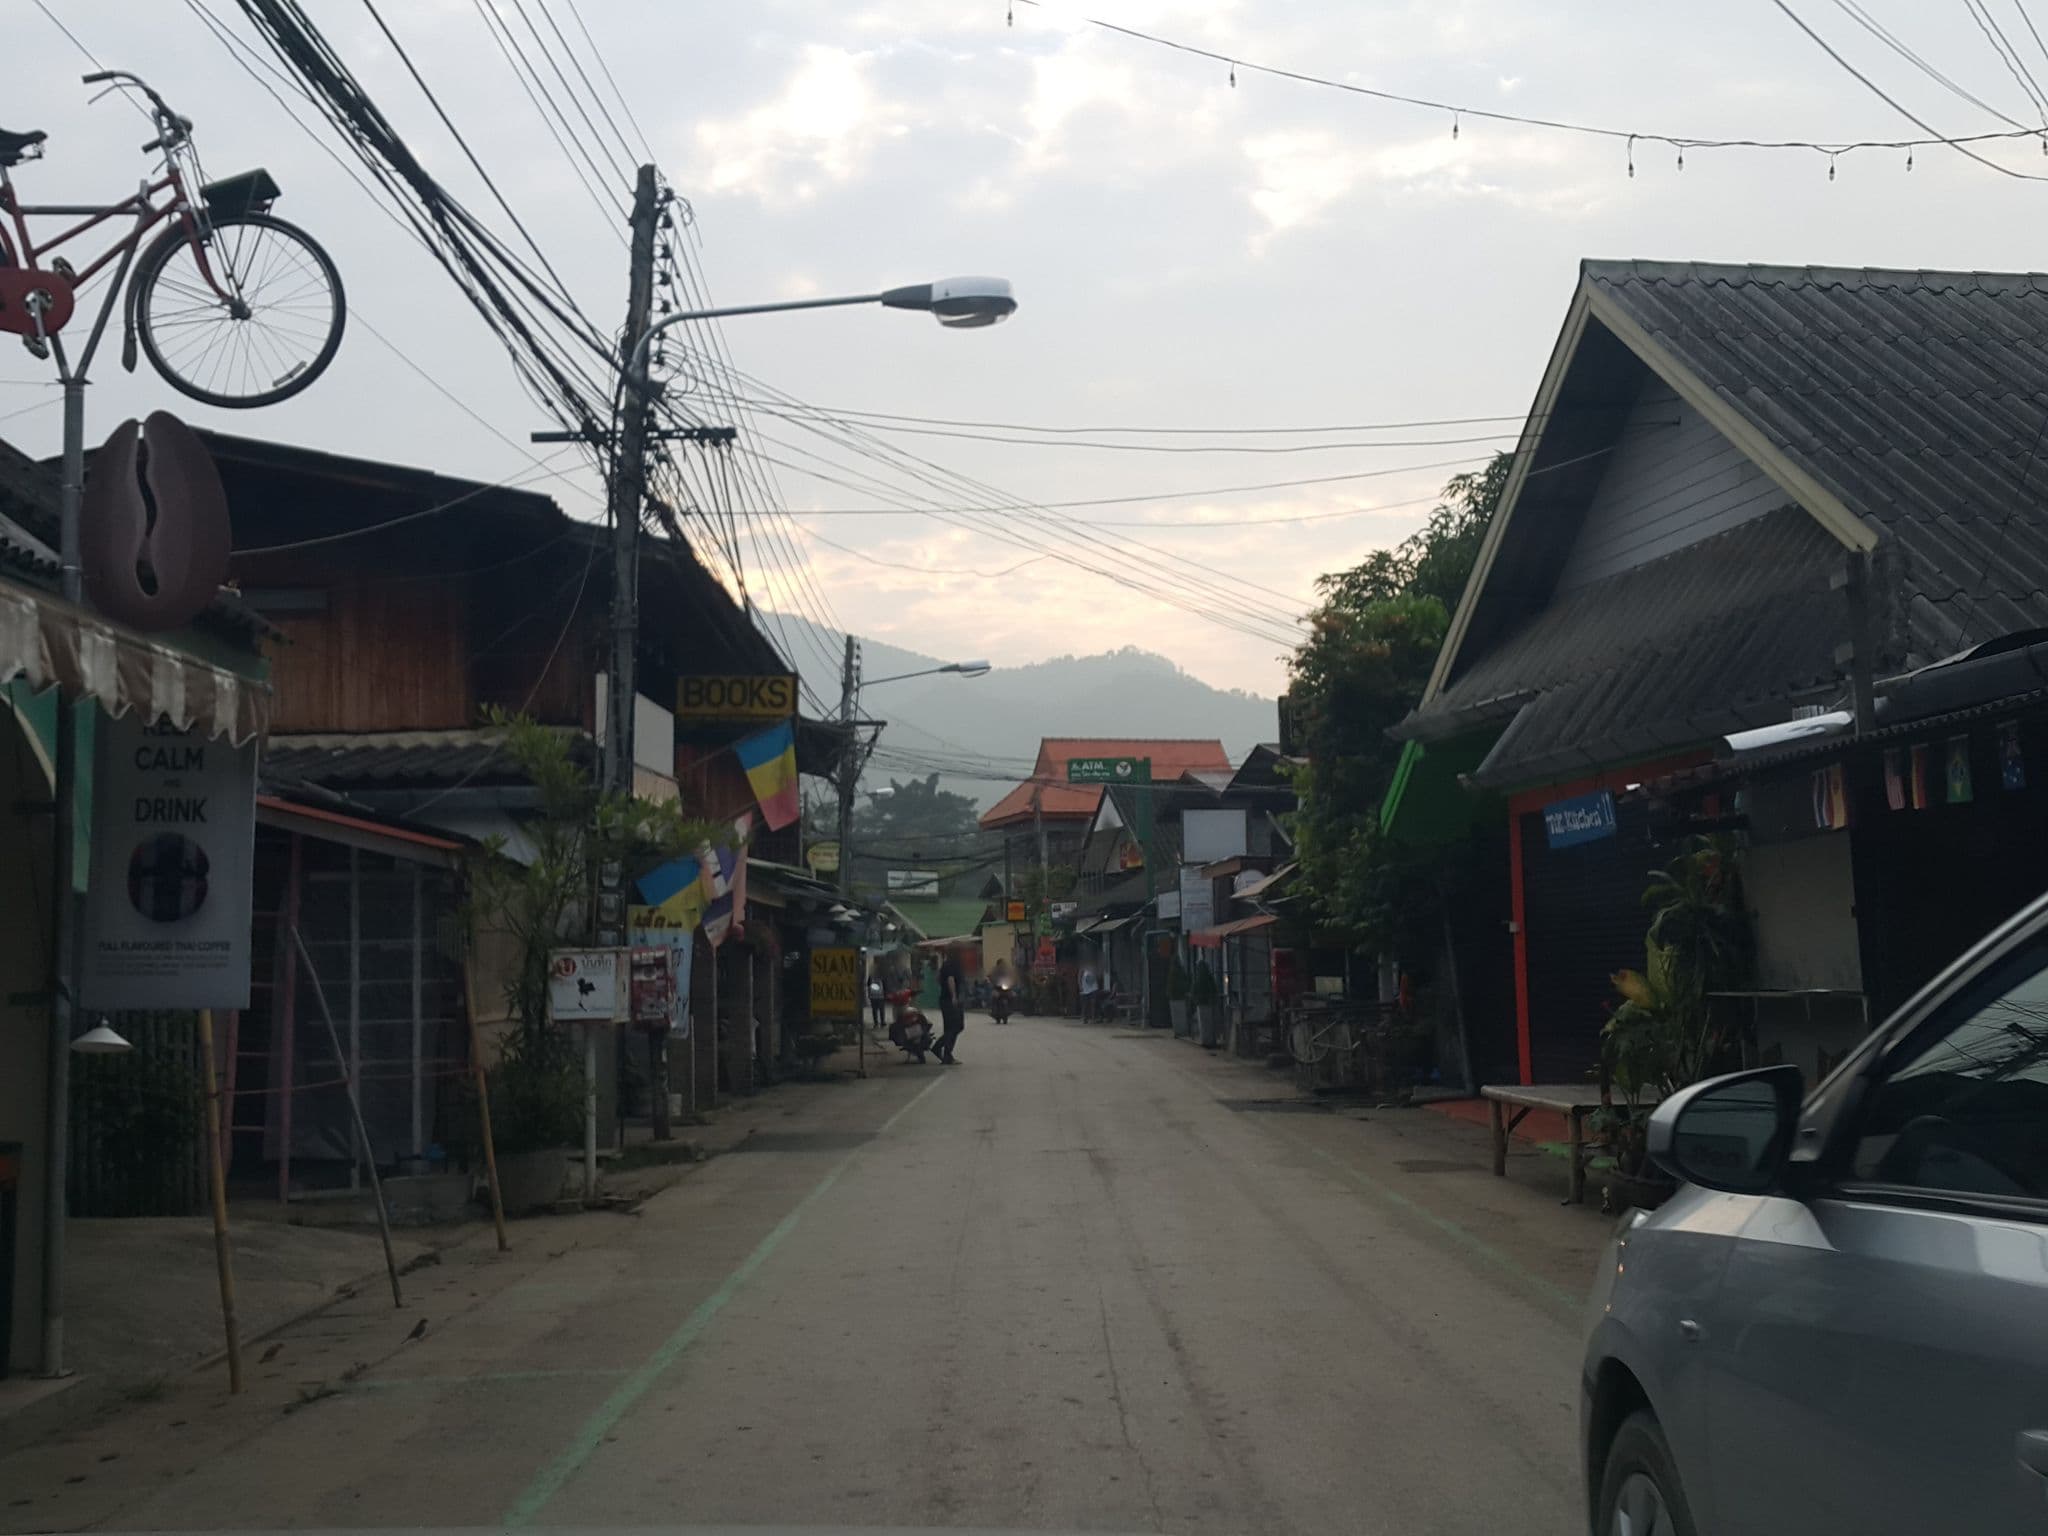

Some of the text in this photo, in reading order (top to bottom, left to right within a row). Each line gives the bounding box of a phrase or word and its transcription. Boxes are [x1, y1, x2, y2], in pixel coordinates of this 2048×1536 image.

[685, 679, 788, 709] BOOKS
[135, 746, 204, 771] CALM
[135, 798, 208, 823] DRINK
[814, 955, 854, 974] SIAM
[812, 983, 856, 1001] BOOKS
